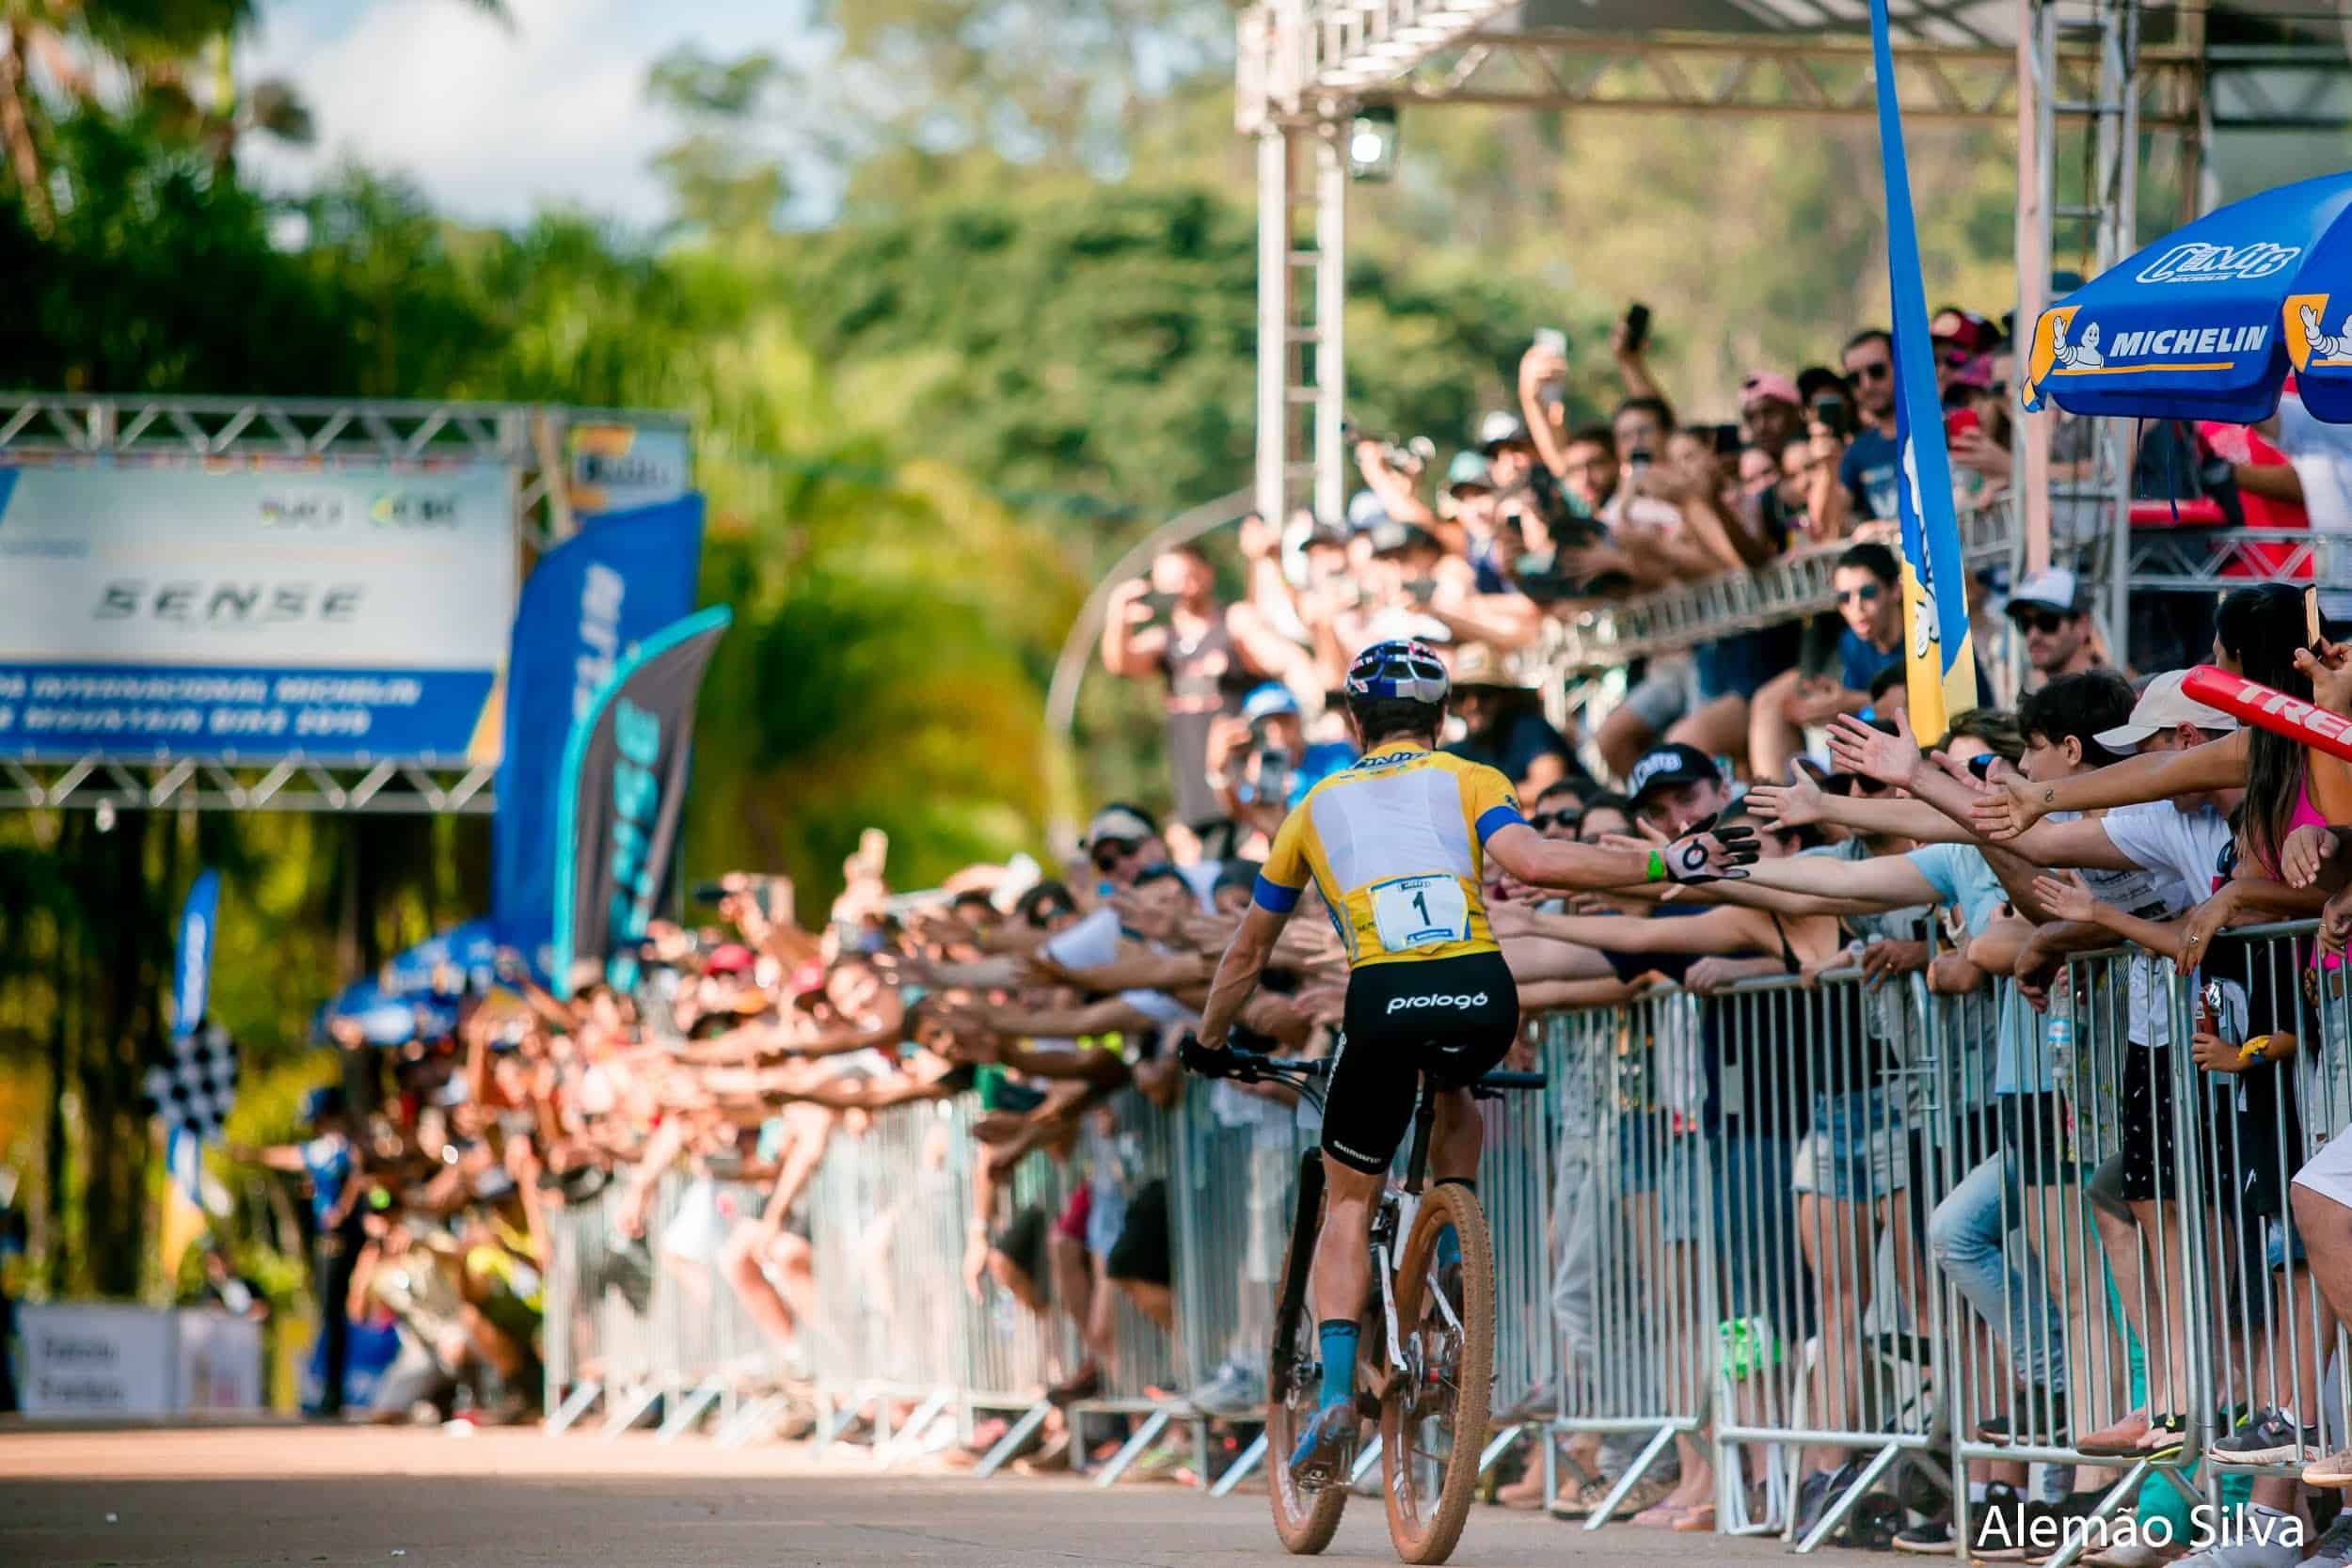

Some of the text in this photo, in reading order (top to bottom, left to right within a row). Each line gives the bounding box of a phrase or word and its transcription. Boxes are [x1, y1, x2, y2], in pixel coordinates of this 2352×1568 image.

[2109, 325, 2268, 358] MICHELIN
[96, 580, 363, 621] SENSE
[1413, 891, 1432, 927] 1
